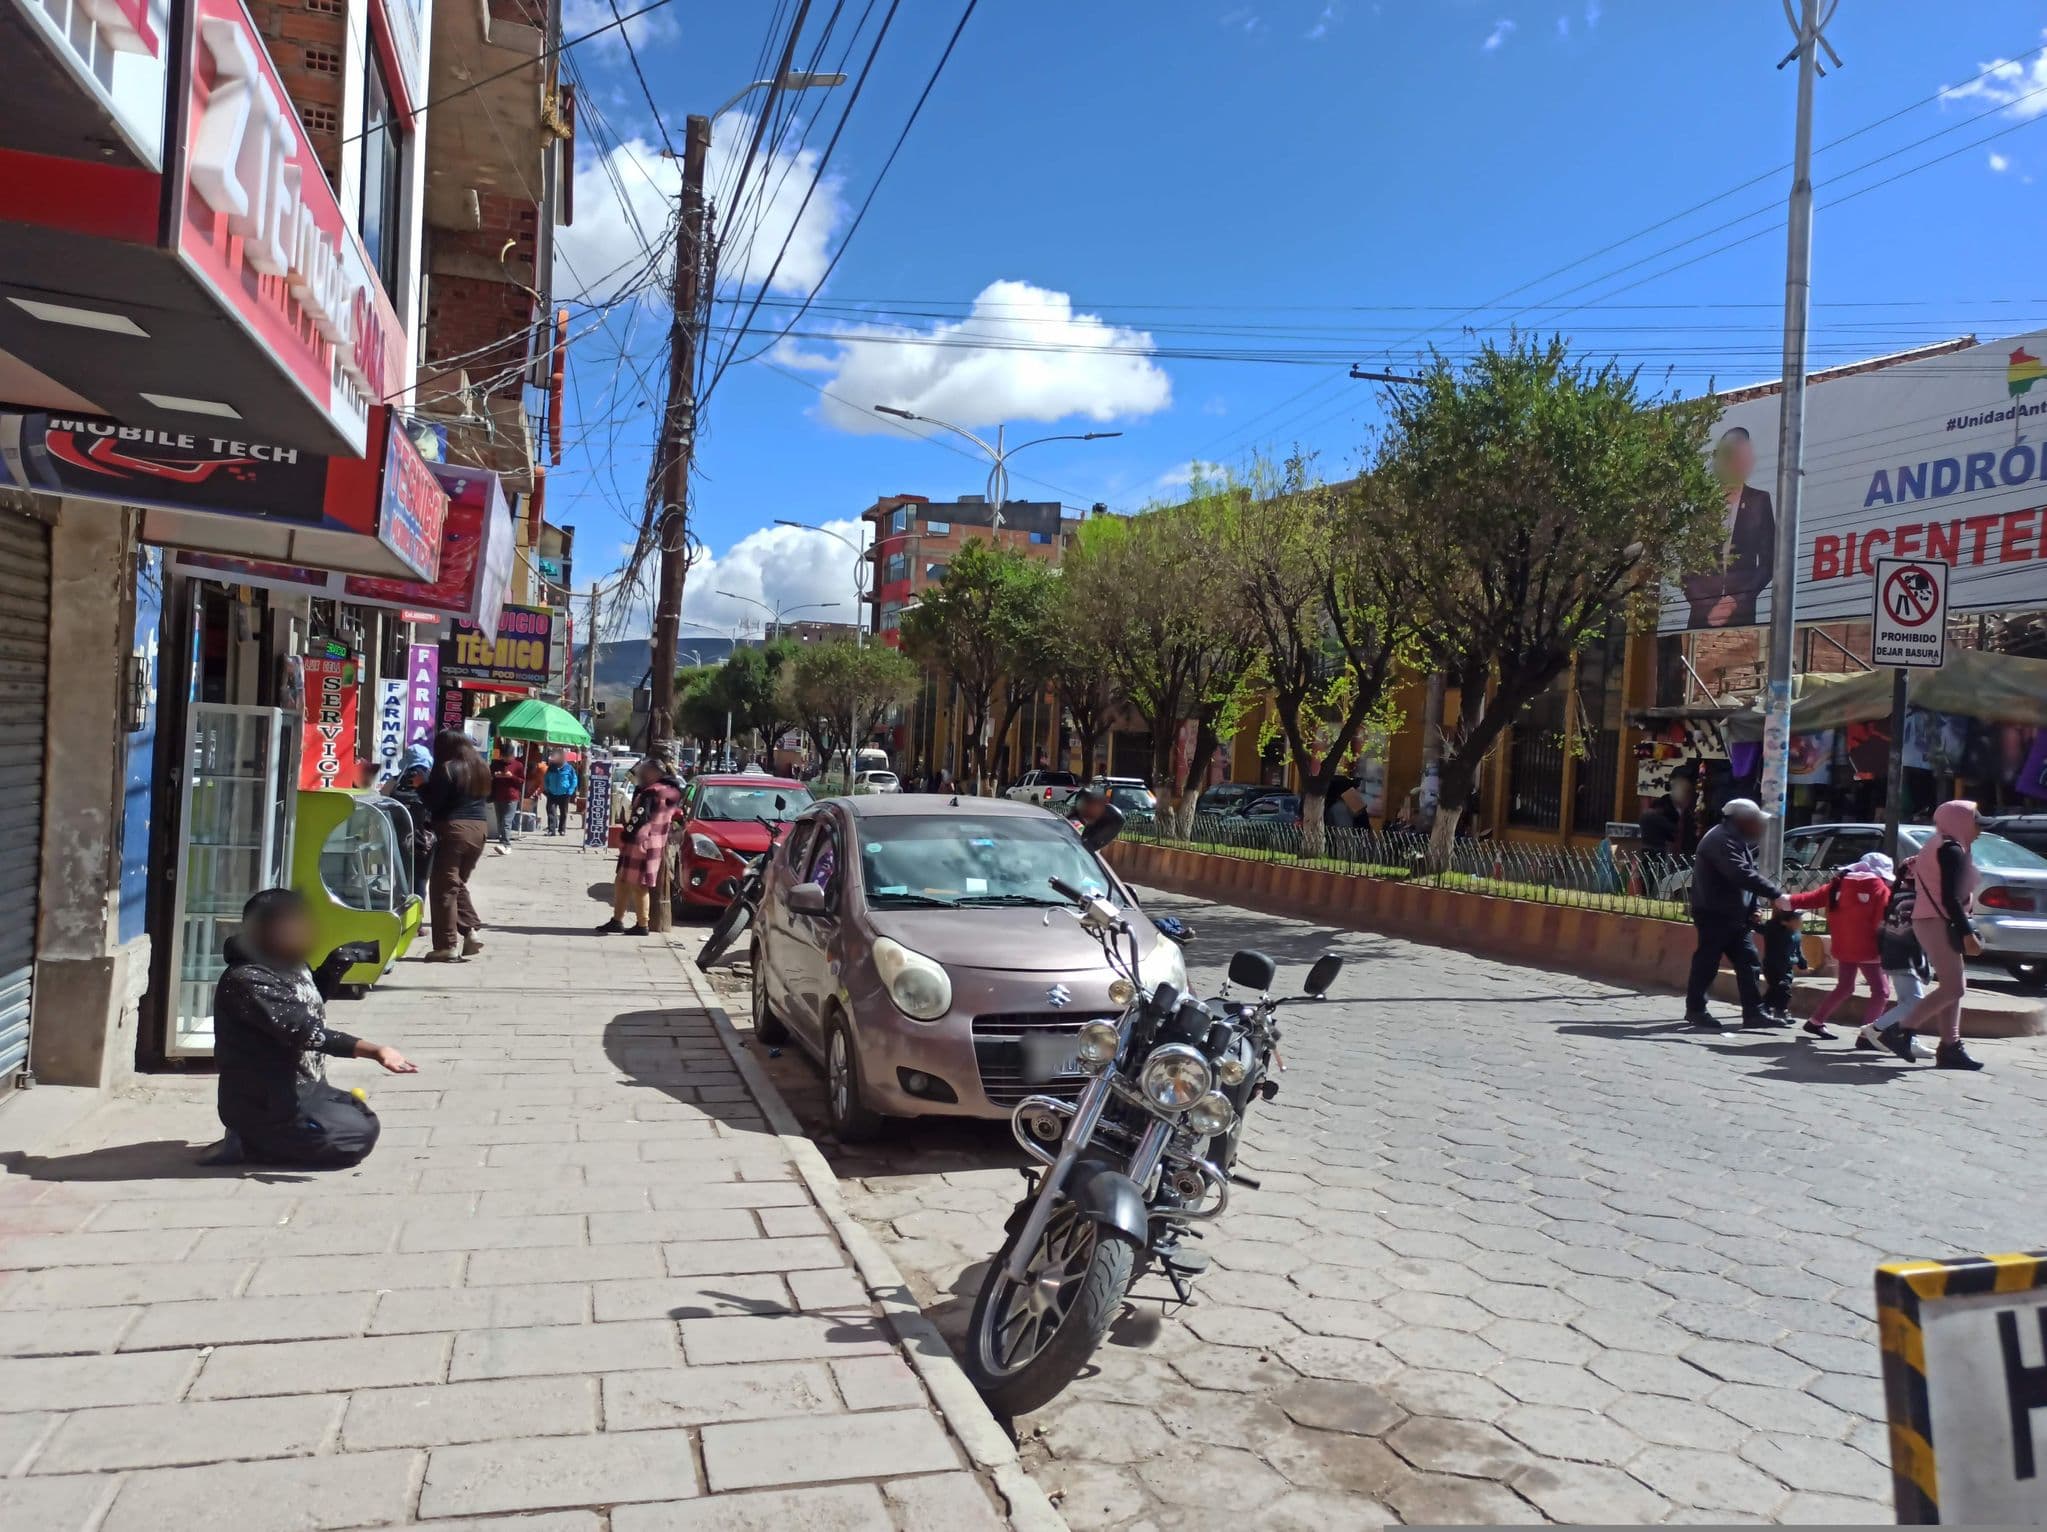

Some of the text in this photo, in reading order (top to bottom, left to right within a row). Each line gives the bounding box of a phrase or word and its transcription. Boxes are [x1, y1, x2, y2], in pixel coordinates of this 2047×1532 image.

[1946, 401, 2047, 431] #UnidadAnt
[50, 419, 298, 464] MOBILE TECH
[1864, 435, 2047, 507] ANDRÓ
[456, 629, 545, 670] TÉCNICO
[1876, 647, 1939, 658] DEJAR BASURA
[1881, 632, 1937, 643] PROHIBIDO
[381, 683, 401, 783] FARMACIA
